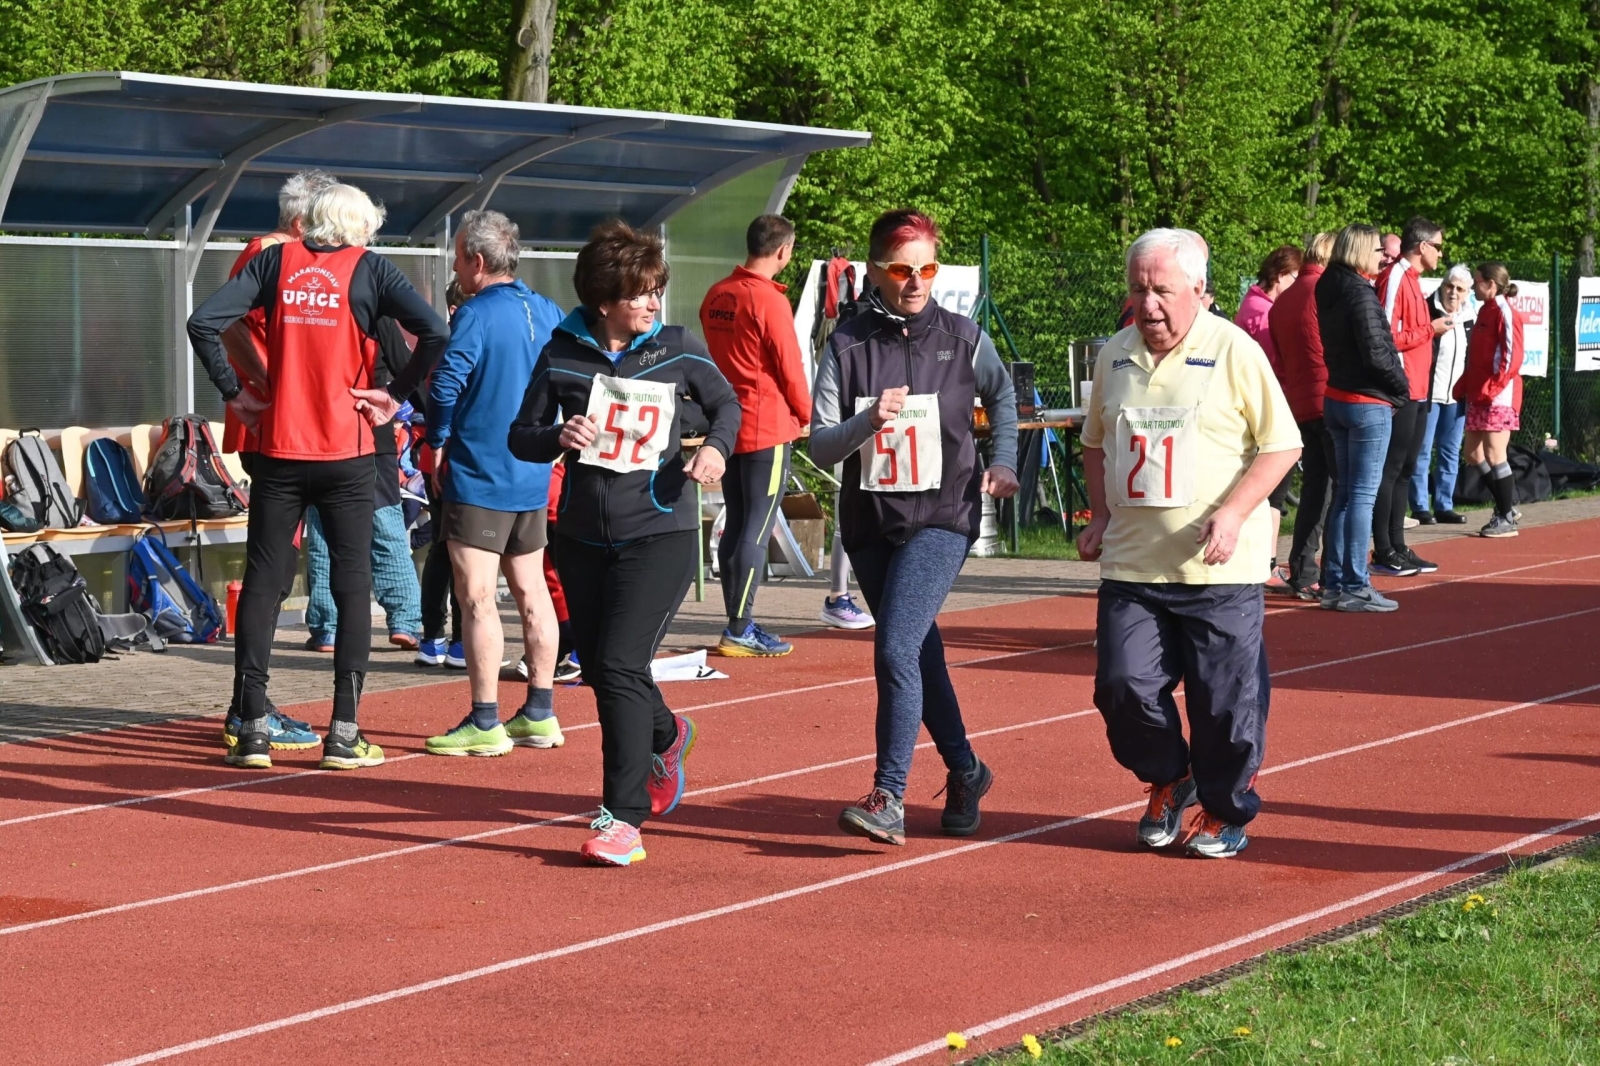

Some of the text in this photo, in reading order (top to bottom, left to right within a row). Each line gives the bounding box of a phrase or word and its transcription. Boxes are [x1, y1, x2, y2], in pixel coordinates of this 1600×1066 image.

[287, 267, 339, 286] MARATONSTAV
[1508, 295, 1543, 312] RATON
[1523, 350, 1542, 365] ORT
[602, 388, 662, 402] PIVOVAR TRUTNOV
[896, 409, 927, 418] TRUTNOV
[1153, 419, 1185, 429] TRUTNOV
[598, 403, 659, 463] 52
[874, 426, 918, 484] 51
[1127, 435, 1173, 498] 21
